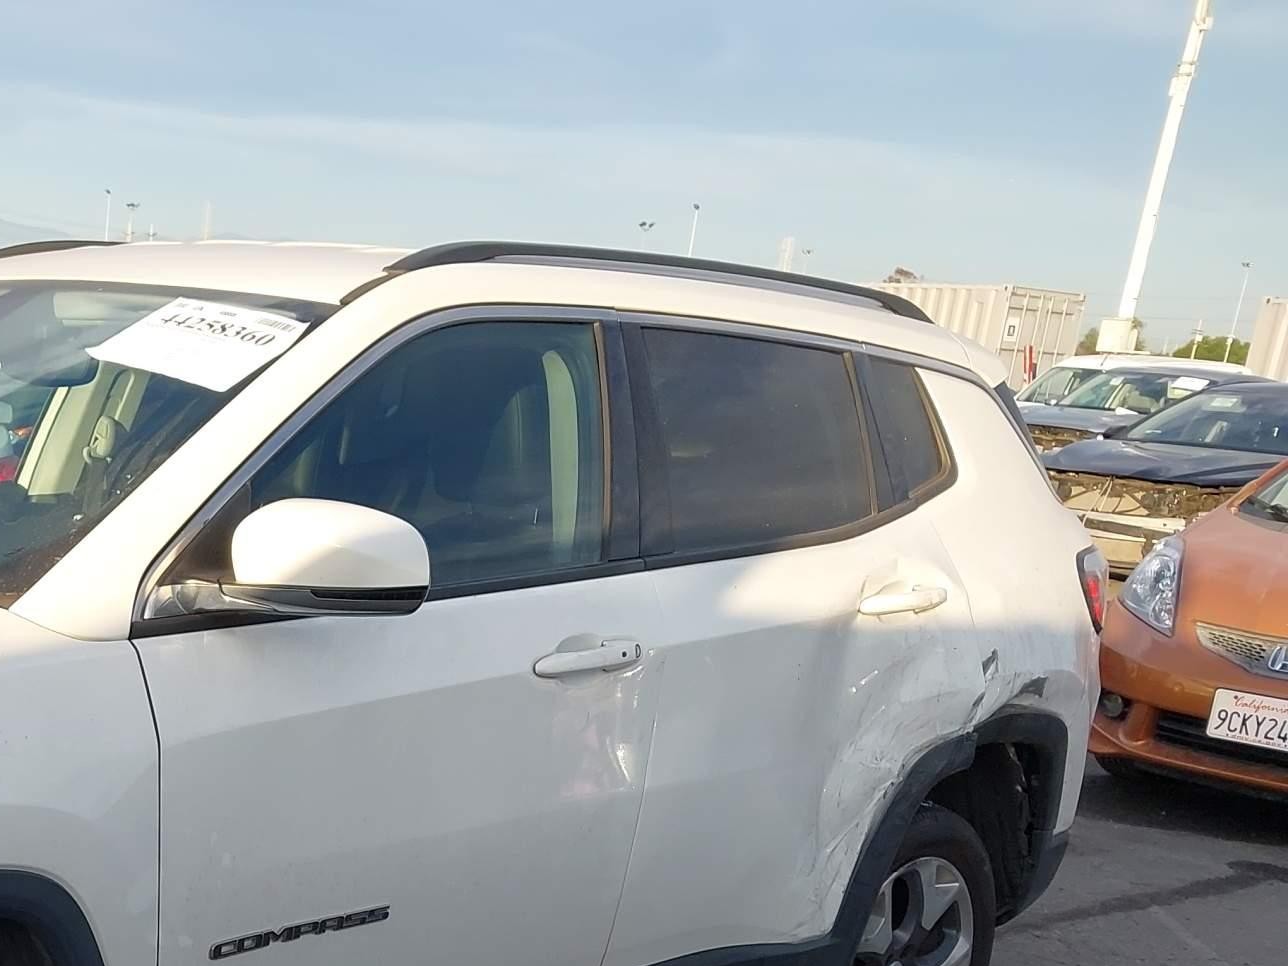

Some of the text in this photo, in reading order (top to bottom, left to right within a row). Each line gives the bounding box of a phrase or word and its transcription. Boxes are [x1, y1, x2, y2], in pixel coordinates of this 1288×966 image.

[161, 313, 276, 346] 44258360
[1214, 709, 1288, 743] 9CKY24
[209, 904, 390, 960] COMPASS
